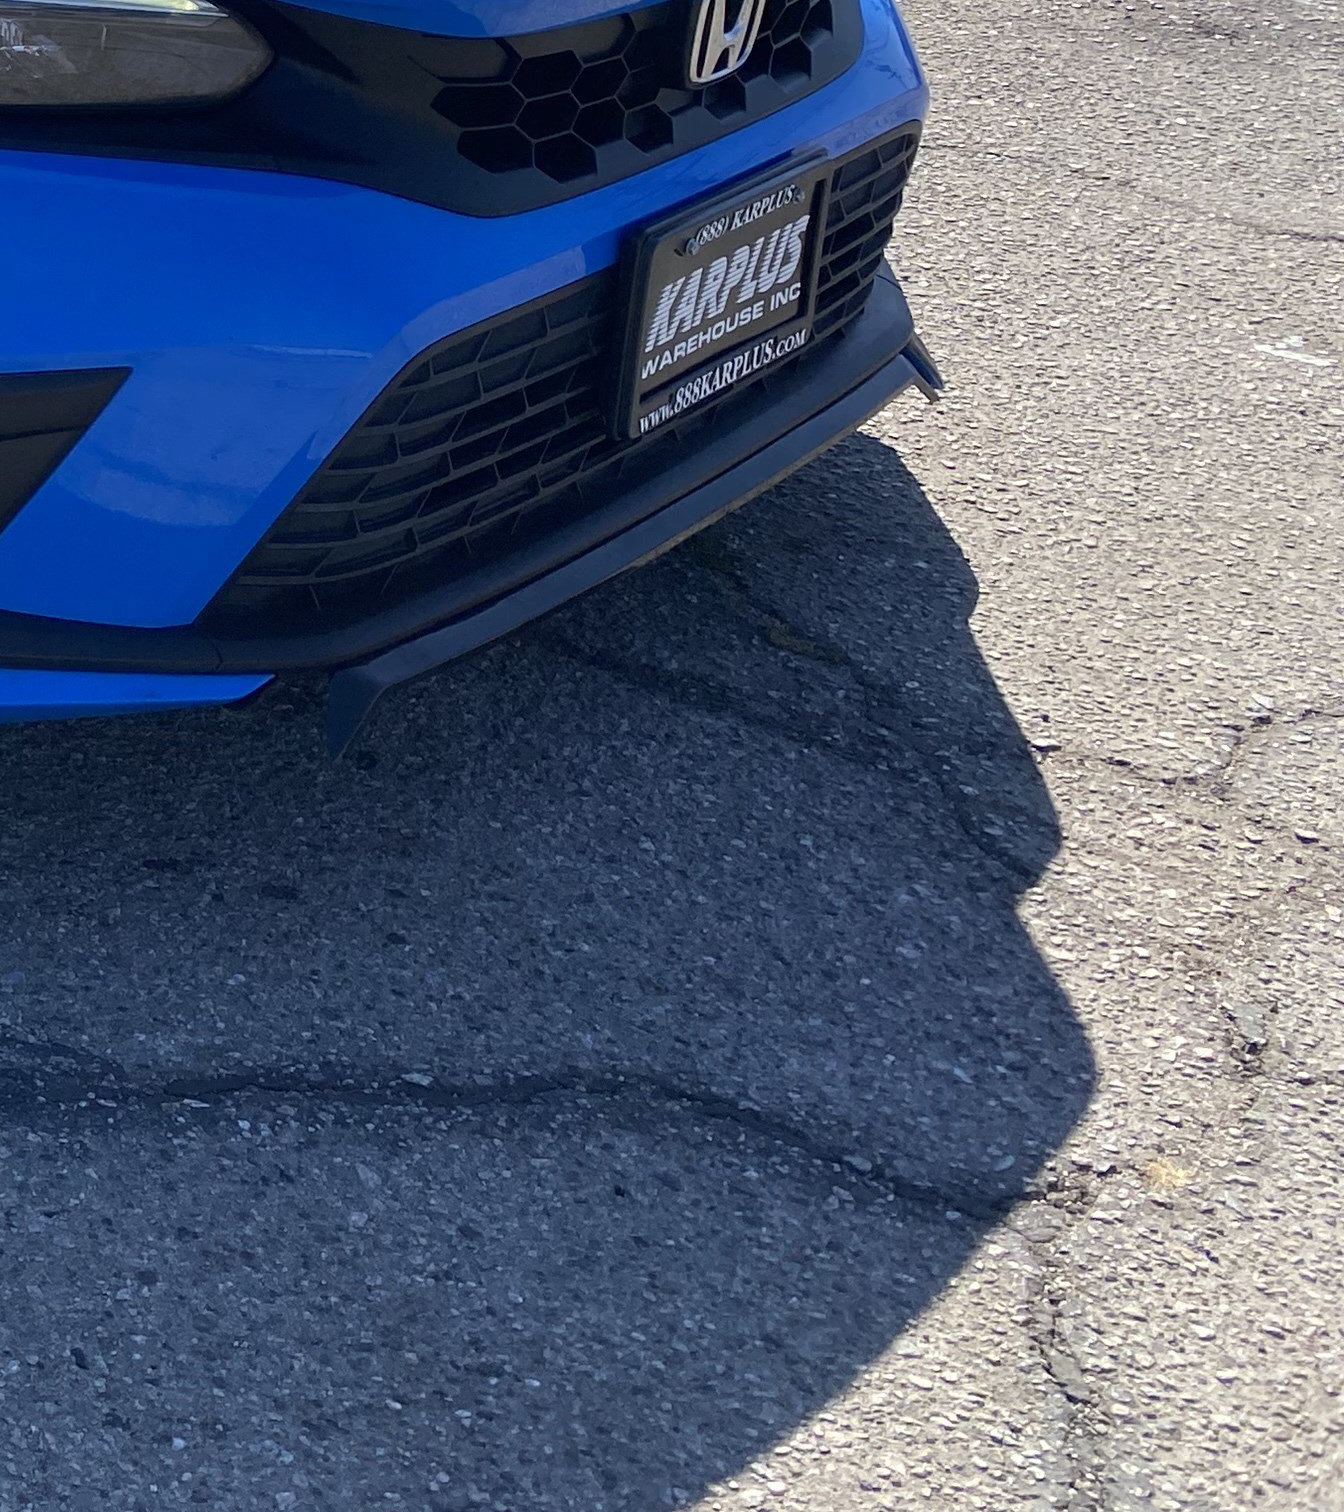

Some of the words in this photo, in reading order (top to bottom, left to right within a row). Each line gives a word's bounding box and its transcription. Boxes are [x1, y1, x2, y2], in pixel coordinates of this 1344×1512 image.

[696, 215, 730, 246] (888)
[730, 184, 796, 232] KARPLUS
[641, 299, 765, 380] WAREHOUSE
[769, 281, 802, 312] INC
[645, 214, 811, 353] KARPLUS
